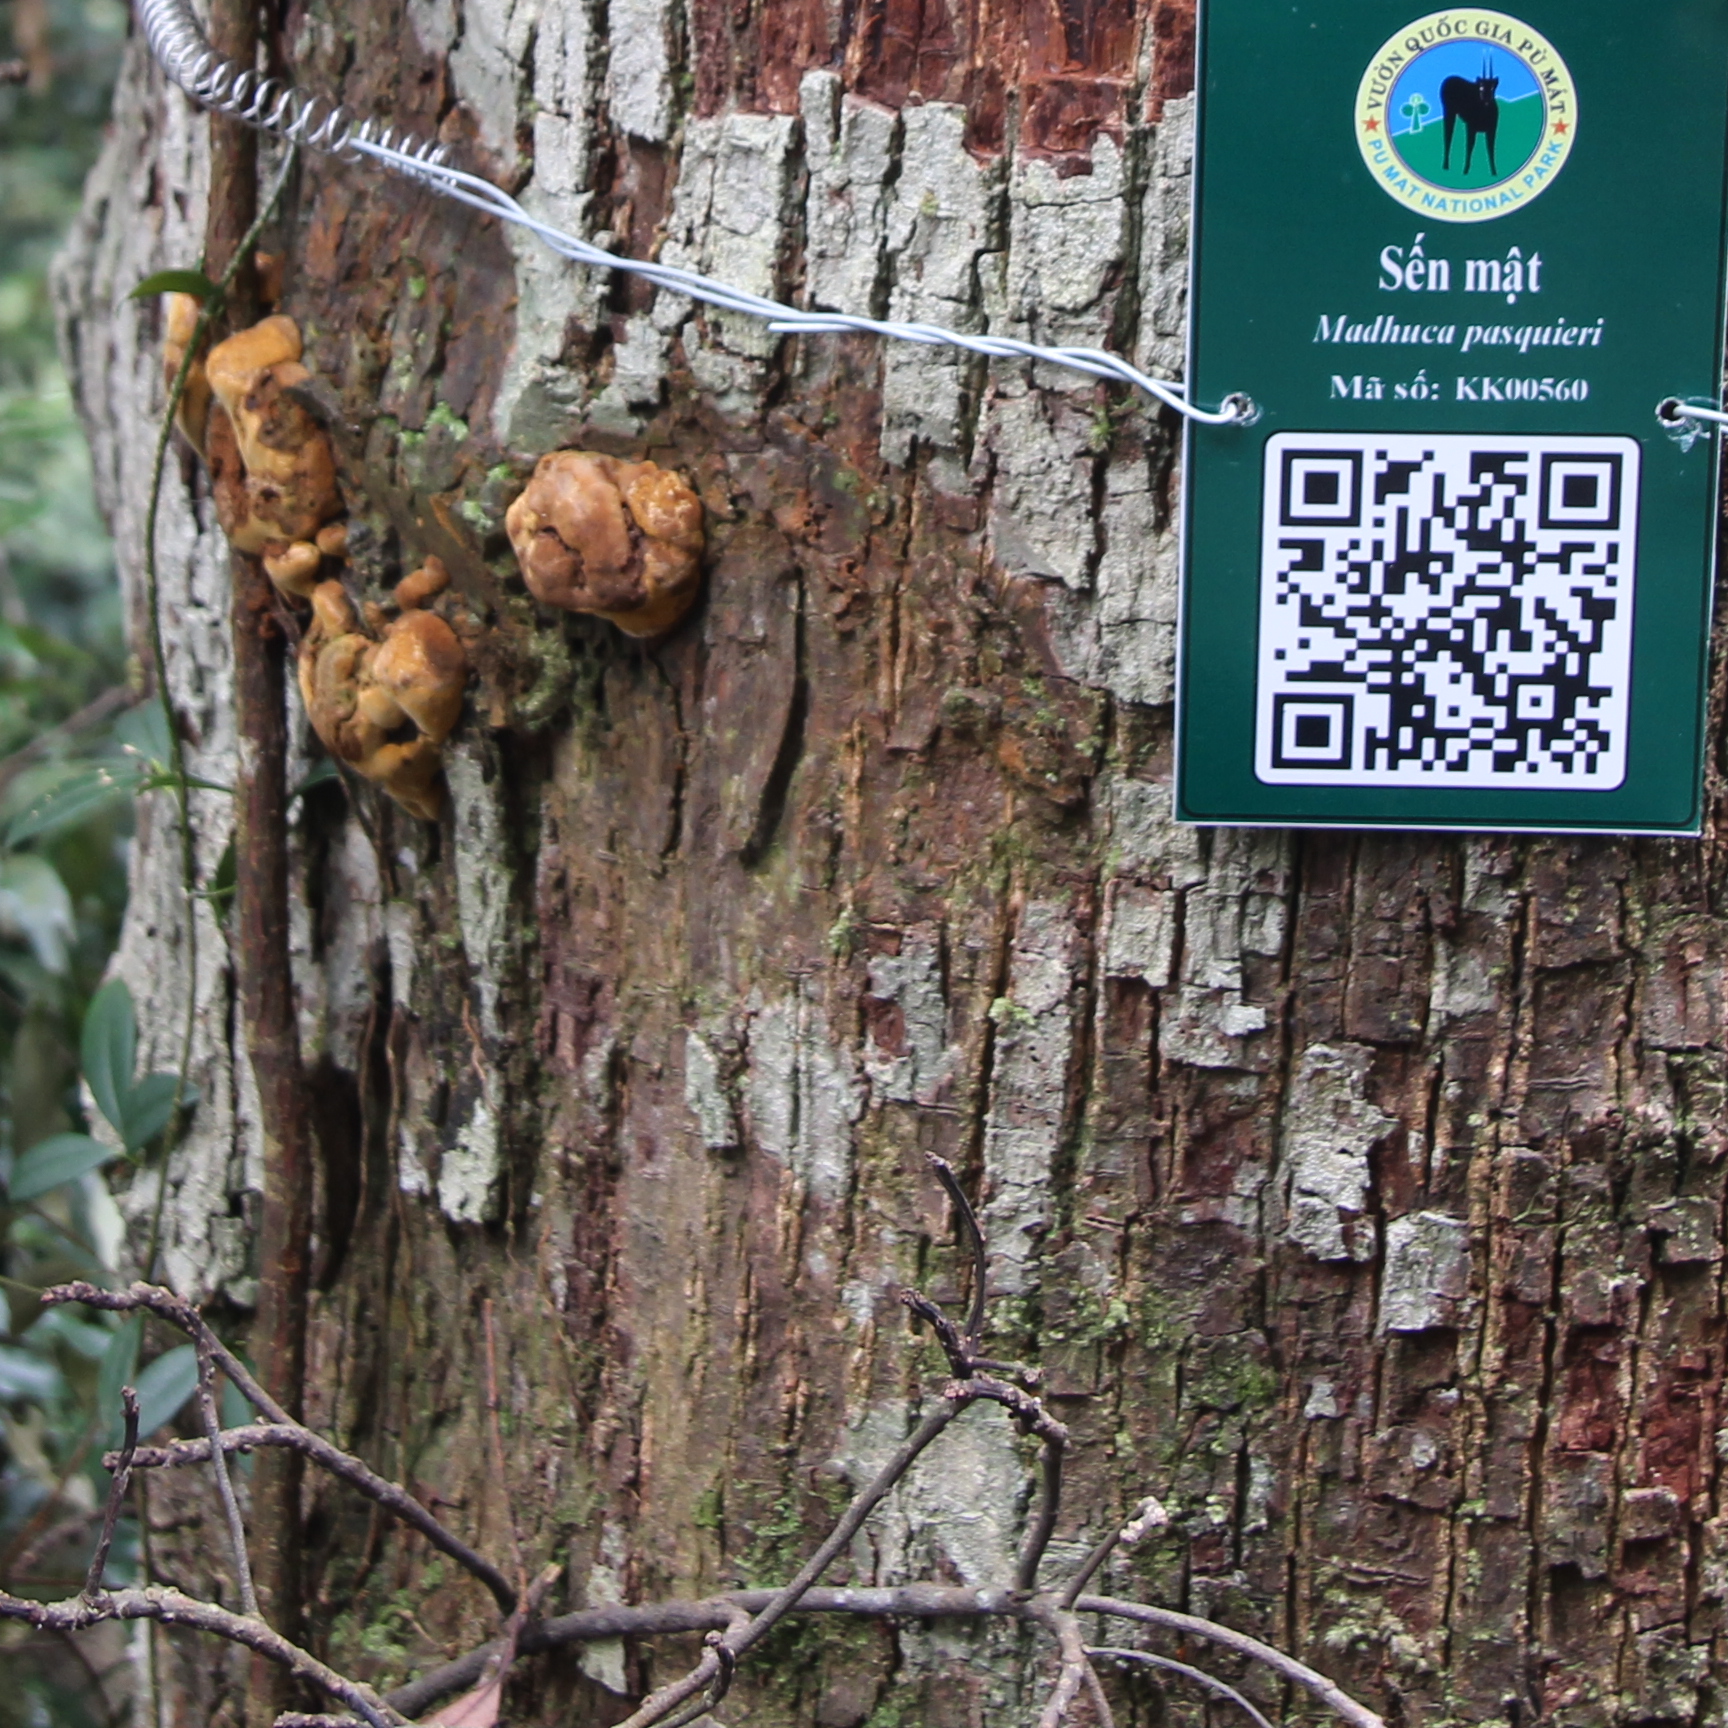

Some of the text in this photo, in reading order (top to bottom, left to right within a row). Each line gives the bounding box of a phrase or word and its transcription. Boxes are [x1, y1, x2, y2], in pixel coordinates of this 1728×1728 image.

[1404, 15, 1469, 52] QUỐC
[1475, 20, 1514, 45] GIA
[1540, 66, 1568, 114] MÁT
[1367, 138, 1564, 214] PU MAT NATIONAL PARK
[1378, 232, 1543, 305] Sến mật
[1312, 314, 1605, 353] Madhuca pasquieri
[1329, 369, 1589, 402] Mã số: KK00560
